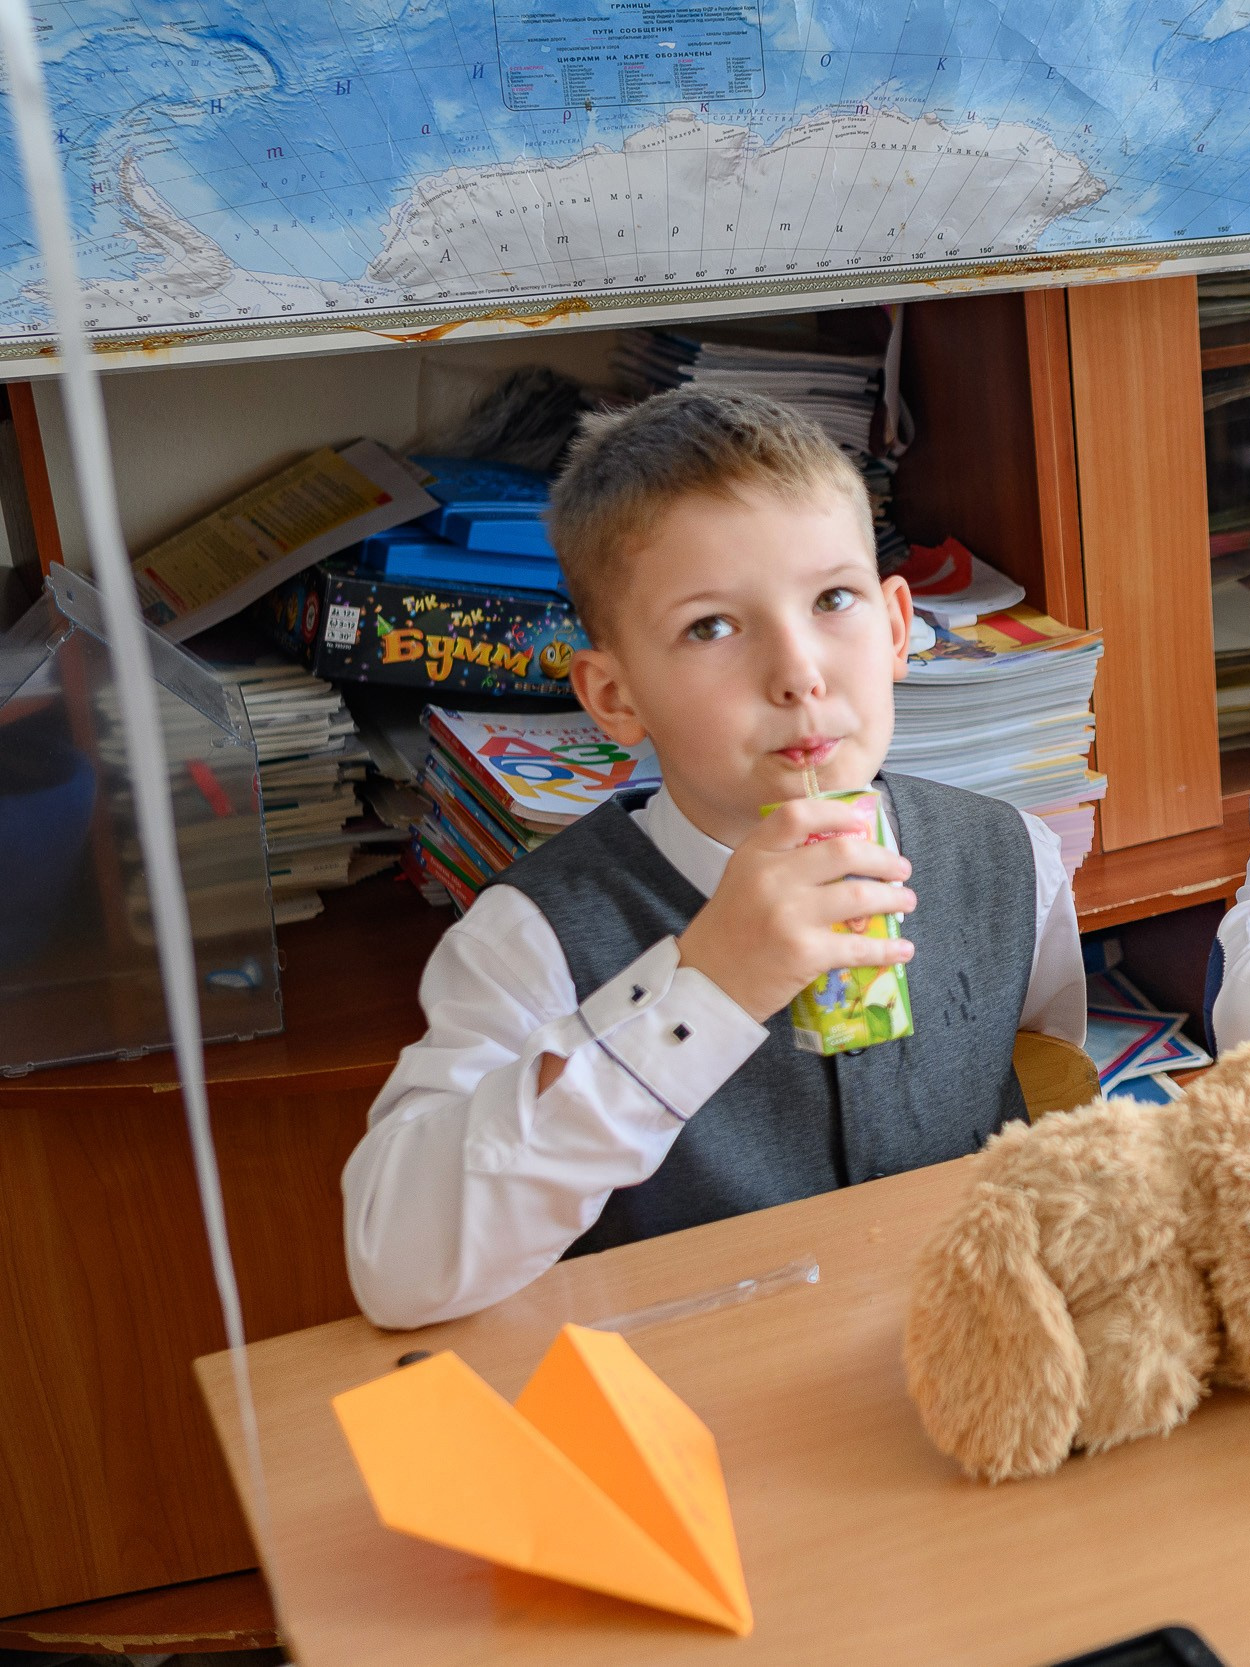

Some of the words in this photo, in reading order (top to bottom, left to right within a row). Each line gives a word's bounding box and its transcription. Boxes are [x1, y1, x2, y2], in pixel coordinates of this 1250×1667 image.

[620, 26, 673, 34] СООБЩЕНИЯ
[655, 51, 712, 59] ОБОЗНАЧЕНЫ
[151, 59, 212, 69] СКОША
[738, 107, 766, 115] МОРЕ
[459, 135, 480, 143] МОРЕ
[870, 142, 917, 151] Земля
[937, 144, 990, 157] Уилкса
[261, 170, 326, 190] МОРЕ
[422, 219, 478, 248] Земля
[496, 196, 591, 218] Королевы
[945, 248, 960, 257] 140°
[980, 245, 995, 254] 150°
[878, 254, 893, 263] 120°
[911, 251, 926, 260] 130°
[816, 259, 832, 268] 100°
[846, 256, 861, 265] 110°
[725, 267, 737, 275] 70°
[755, 264, 767, 273] 80°
[785, 262, 798, 271] 90°
[634, 274, 647, 282] 40°
[664, 272, 677, 280] 50°
[695, 269, 708, 278] 60°
[573, 279, 586, 287] 20°
[603, 276, 616, 285] 30°
[104, 283, 169, 295] Земля
[403, 293, 416, 302] 30°
[438, 290, 451, 299] 20°
[325, 299, 339, 308] 50°
[364, 295, 378, 304] 40°
[237, 306, 251, 315] 70°
[281, 303, 295, 311] 60°
[137, 313, 151, 322] 90°
[189, 309, 203, 319] 80°
[22, 322, 41, 331] 110°
